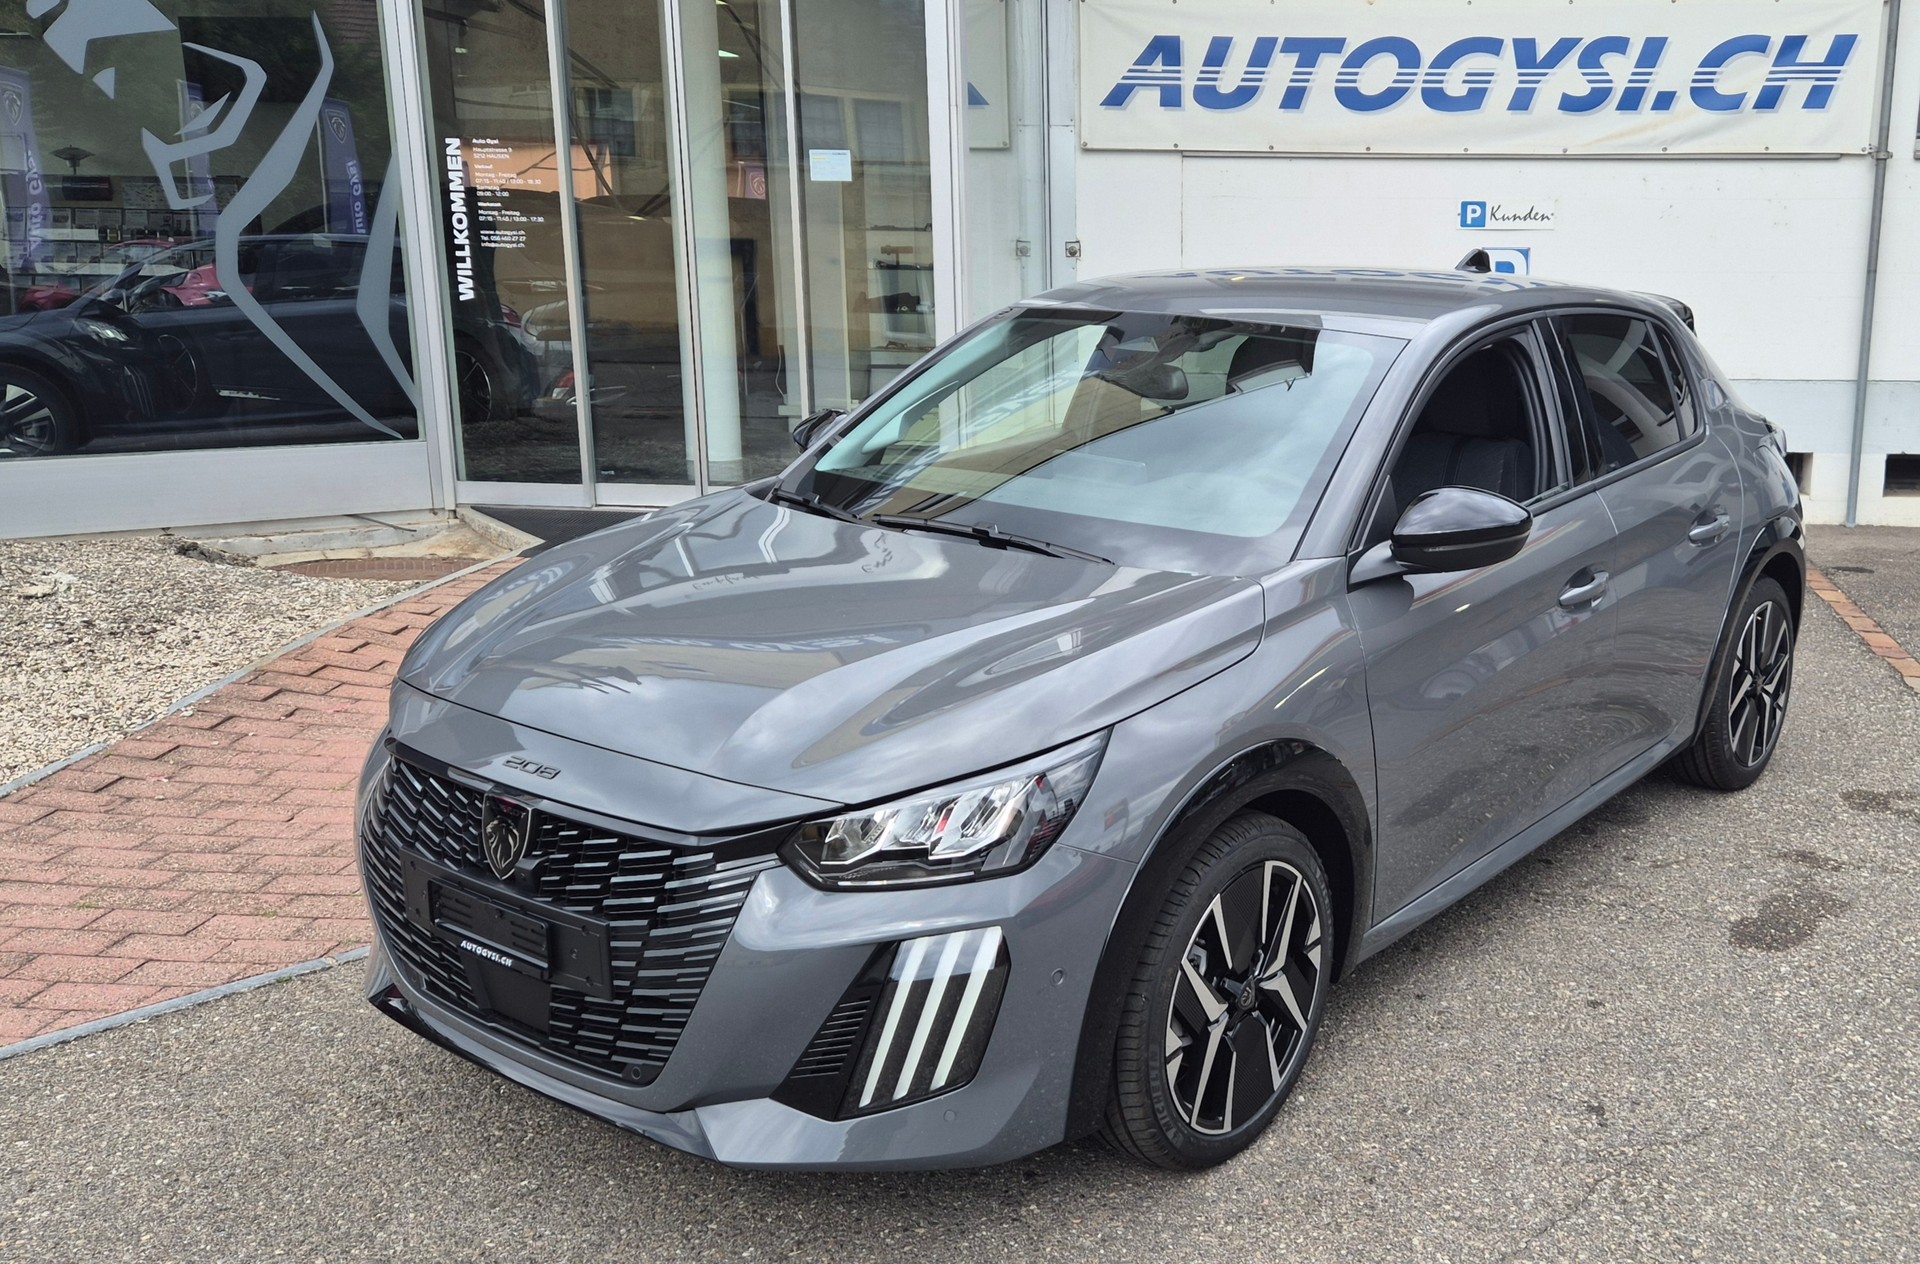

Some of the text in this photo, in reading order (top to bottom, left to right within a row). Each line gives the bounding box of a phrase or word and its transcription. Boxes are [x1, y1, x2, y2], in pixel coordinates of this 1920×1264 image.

[1100, 34, 1858, 112] AUTOGYSI.CH
[445, 137, 475, 301] WILLKOMMEN
[1489, 204, 1551, 222] Kunden
[502, 755, 562, 780] 208
[460, 940, 513, 968] AUTOGYSI.CH
